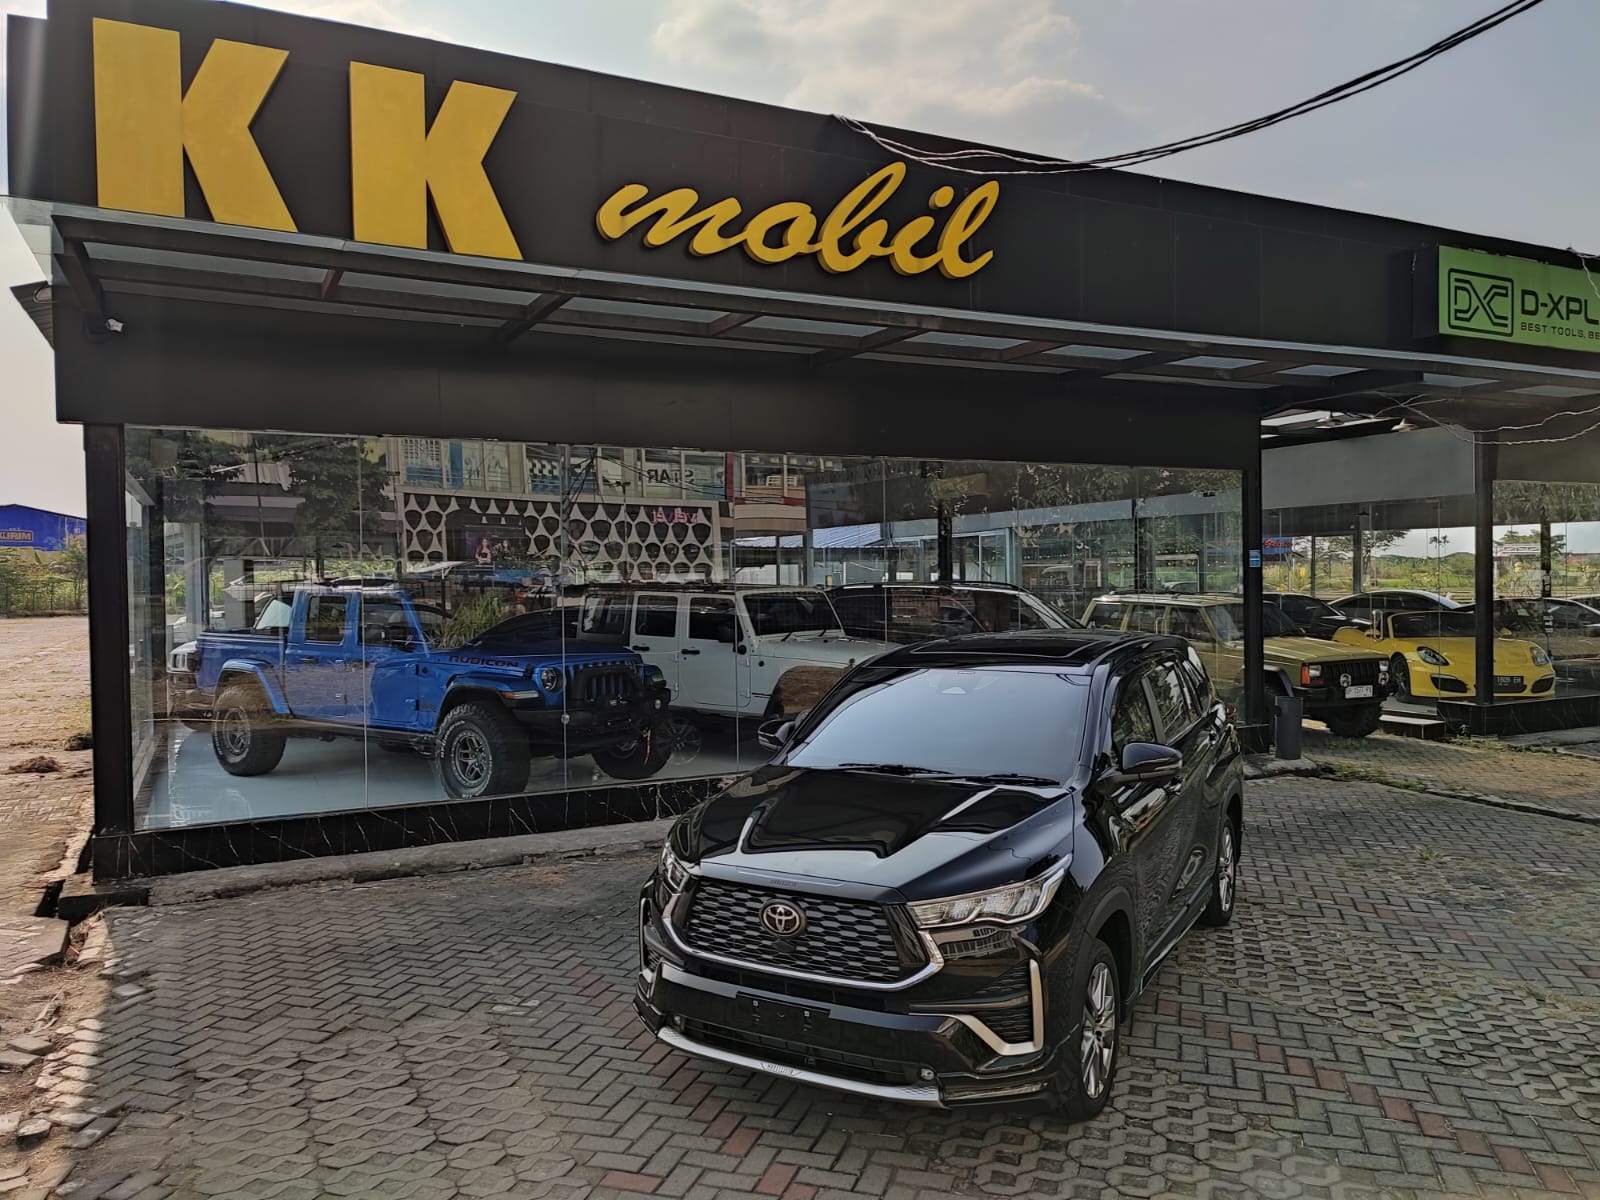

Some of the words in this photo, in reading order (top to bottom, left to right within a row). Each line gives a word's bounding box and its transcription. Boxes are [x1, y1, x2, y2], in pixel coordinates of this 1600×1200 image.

[597, 162, 999, 278] mobil
[1521, 322, 1548, 333] BEST
[1551, 326, 1586, 339] TOOLS,
[448, 655, 519, 667] RUBICON
